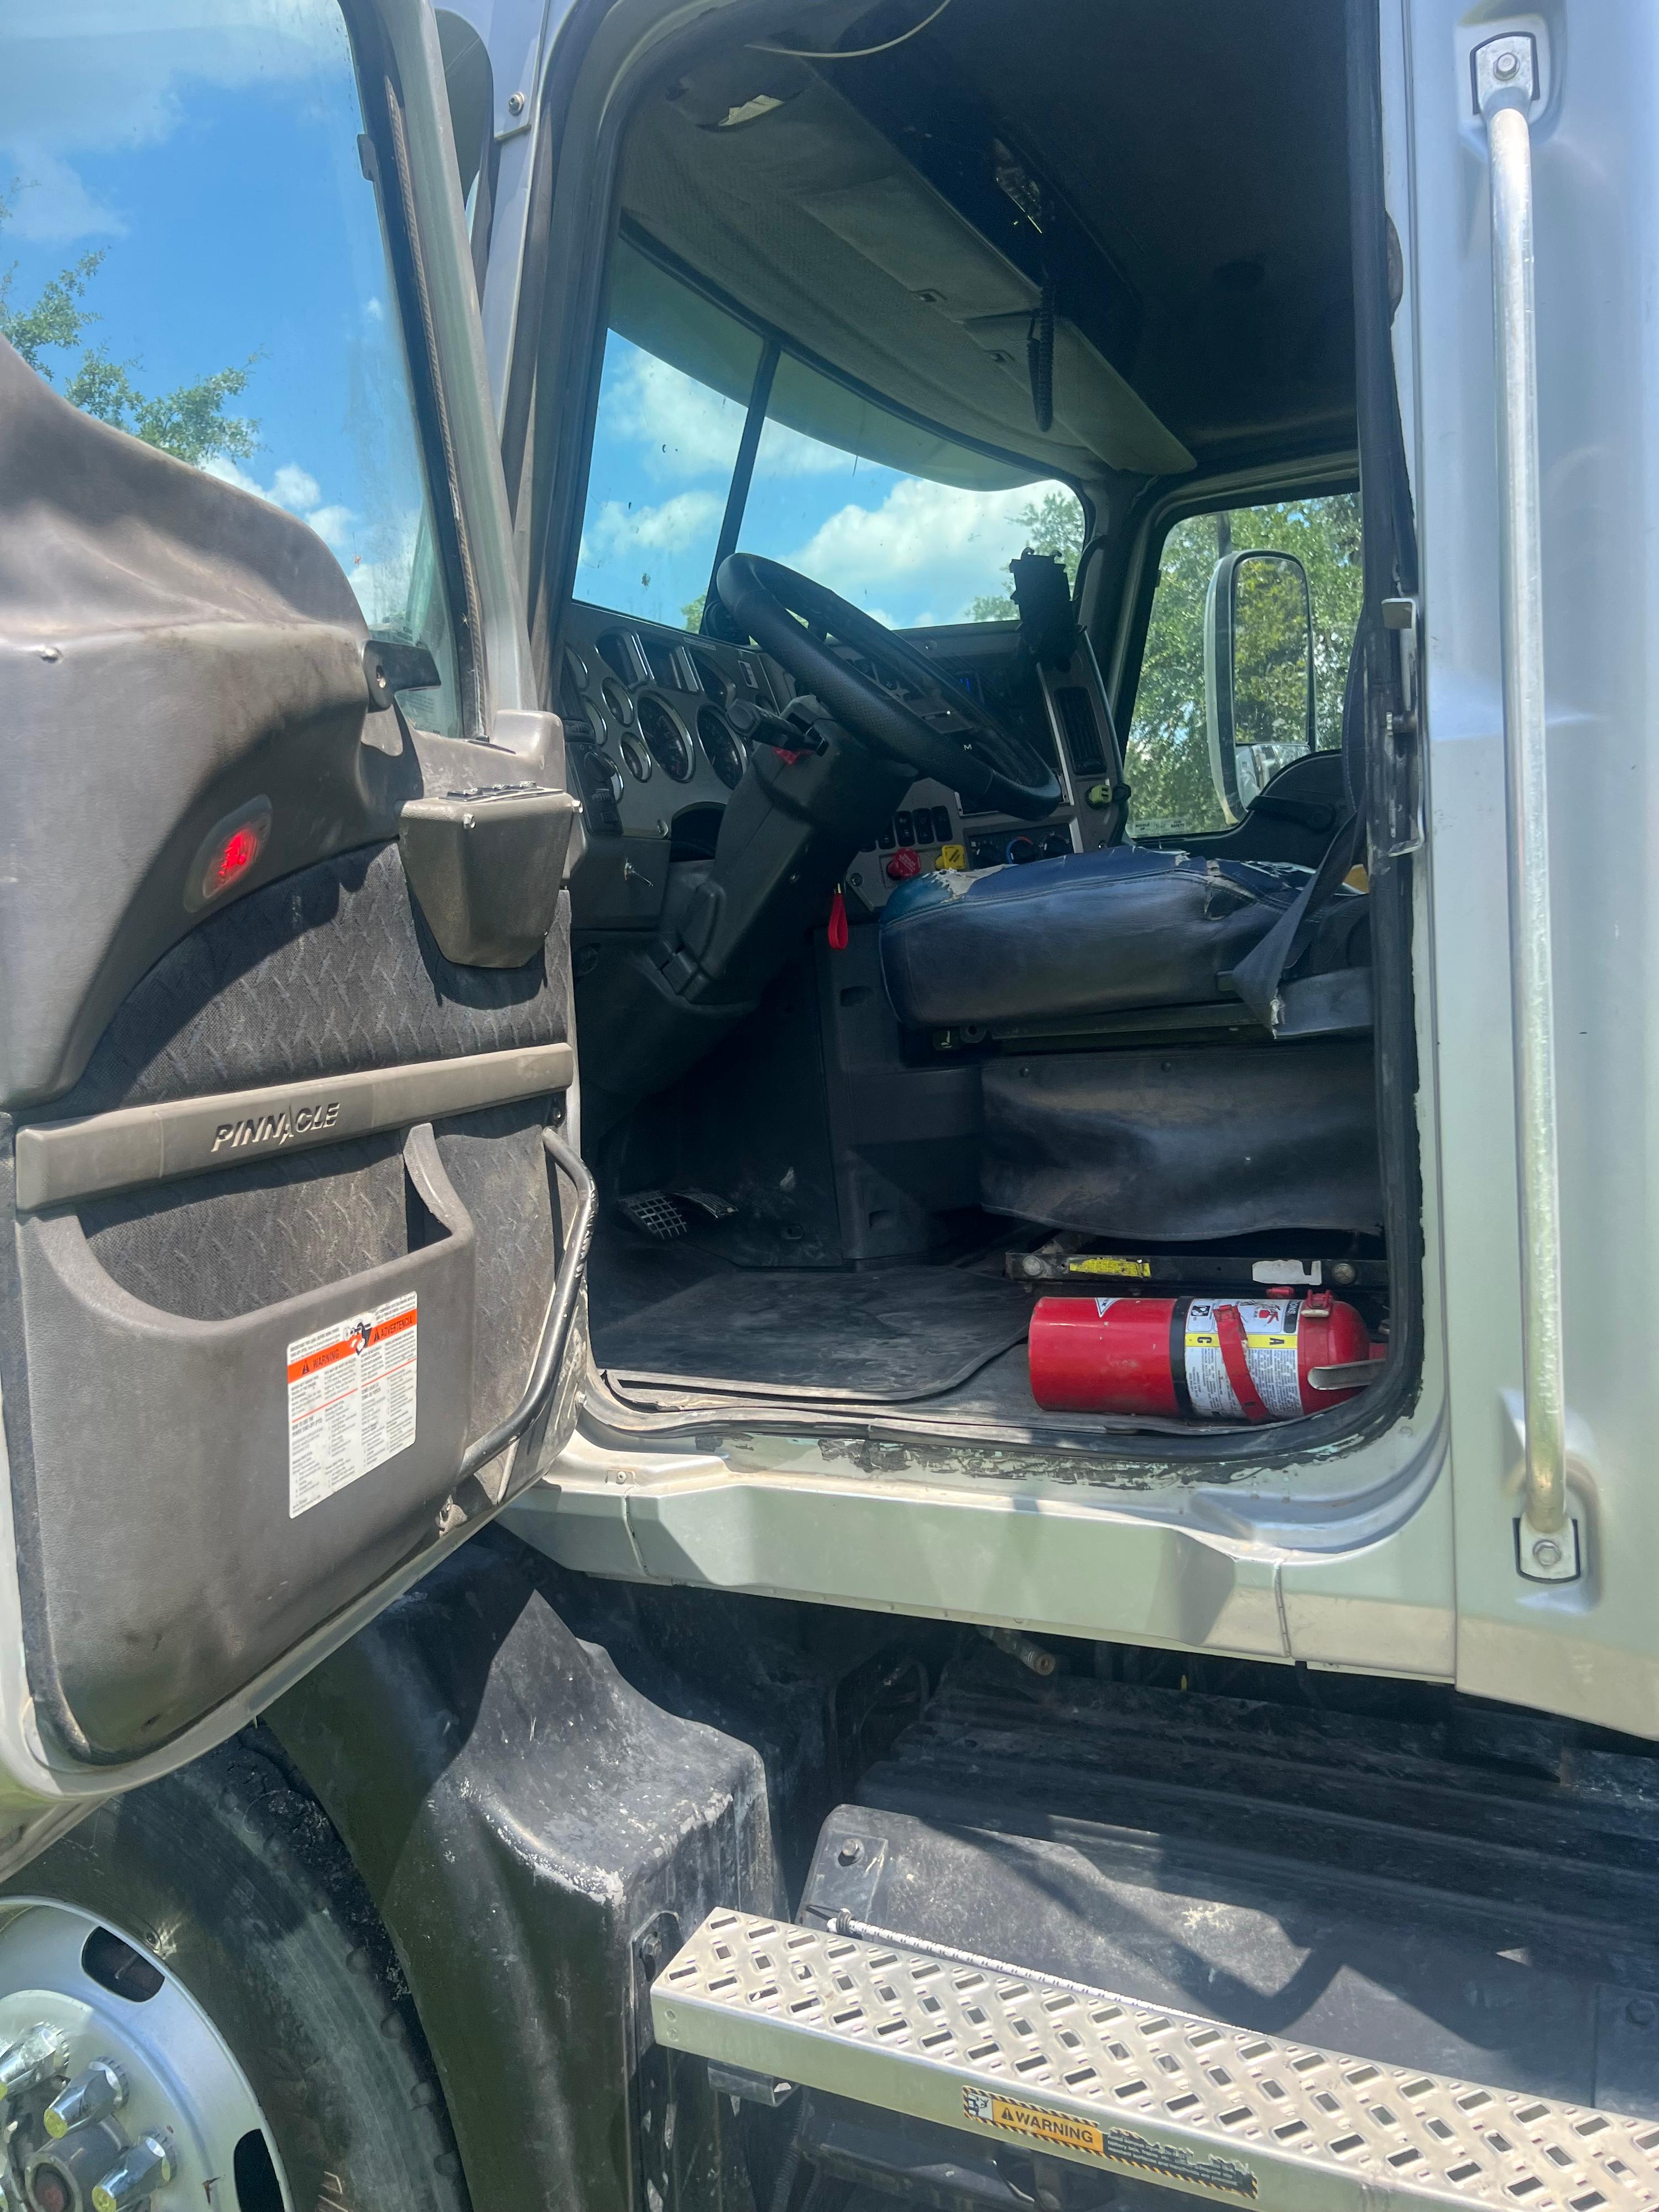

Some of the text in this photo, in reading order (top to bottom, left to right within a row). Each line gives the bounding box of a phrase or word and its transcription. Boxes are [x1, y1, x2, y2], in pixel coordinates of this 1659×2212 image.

[211, 1102, 340, 1152] PINNACLE
[380, 1316, 413, 1338] ADVERTENCIA
[1269, 1337, 1285, 1345] A
[313, 1349, 339, 1368] WARNING
[1015, 2111, 1093, 2143] WARNING
